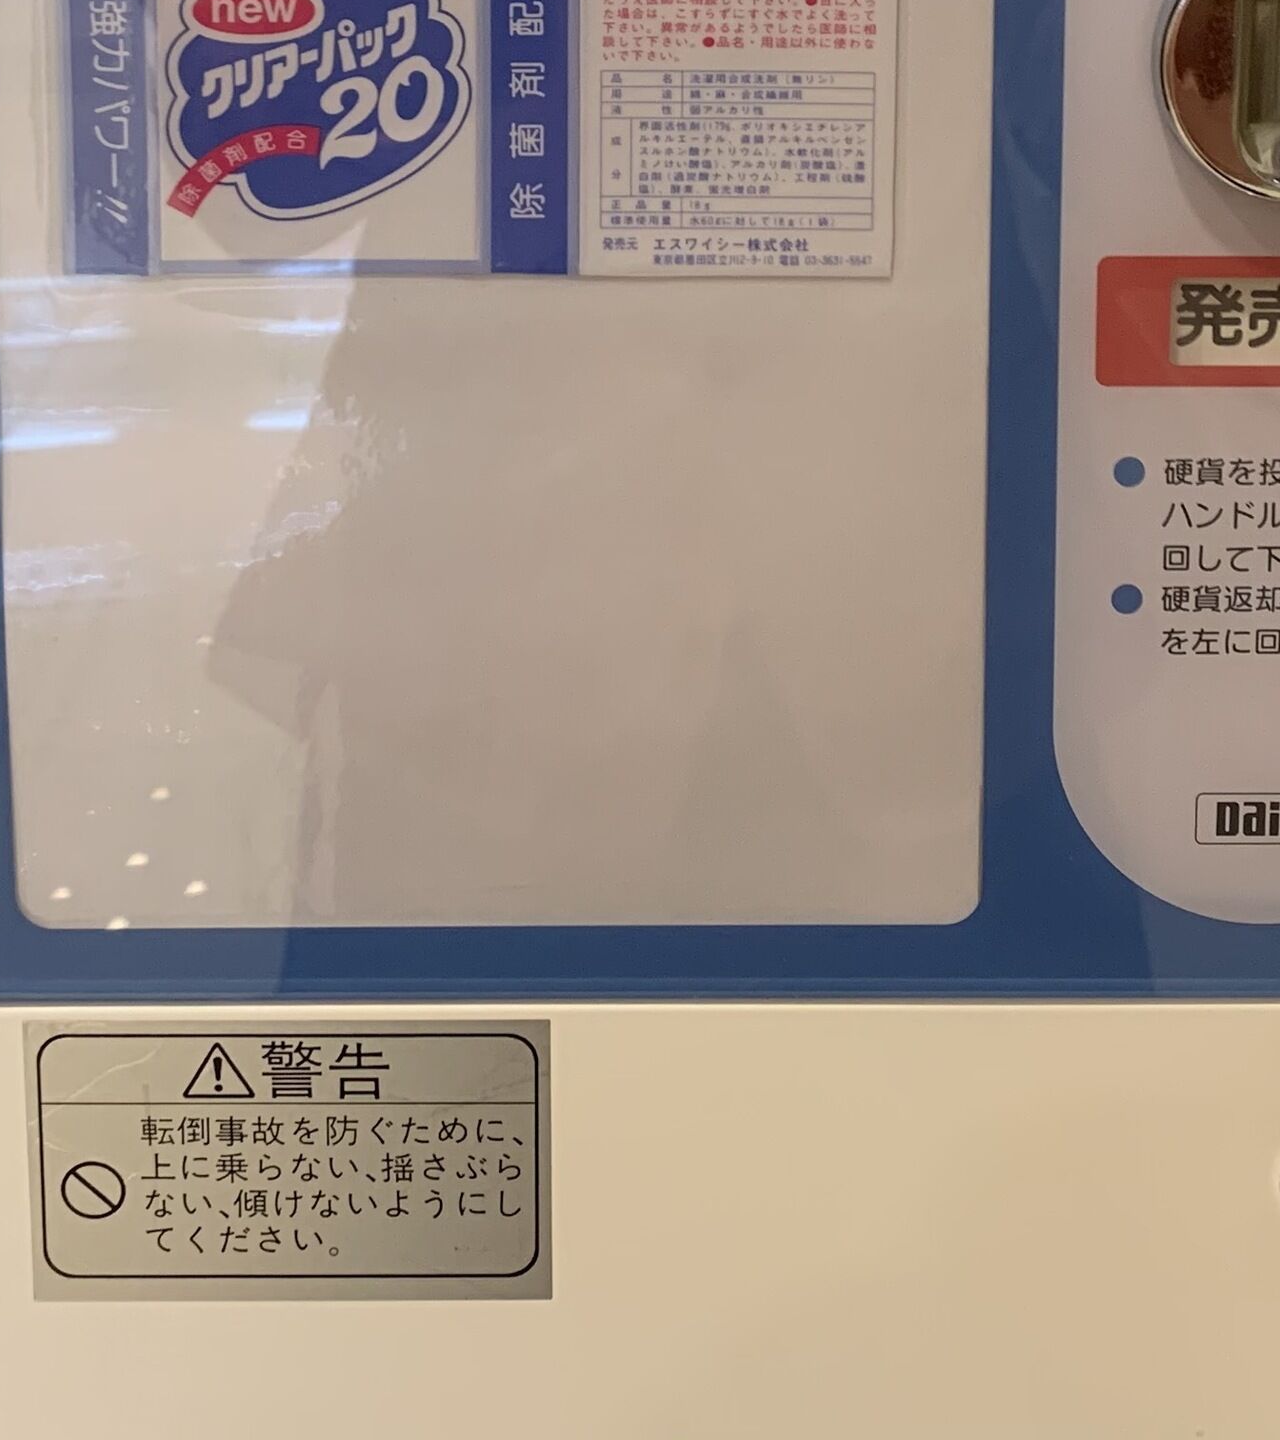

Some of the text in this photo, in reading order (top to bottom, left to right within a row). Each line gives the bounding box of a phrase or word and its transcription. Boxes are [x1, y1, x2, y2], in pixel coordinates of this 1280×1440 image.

[202, 3, 417, 119] クリアーパック
[320, 55, 445, 170] 20
[177, 129, 308, 207] 除菌剤配合
[653, 237, 809, 252] エスワイシー株式会社
[261, 1040, 391, 1100] 警告
[140, 1115, 524, 1147] 転倒事故を防ぐために、
[140, 1151, 522, 1183] 上に乗らない、揺さぶら
[145, 1188, 522, 1219] ない、傾けないようにし
[145, 1225, 340, 1257] てください。
